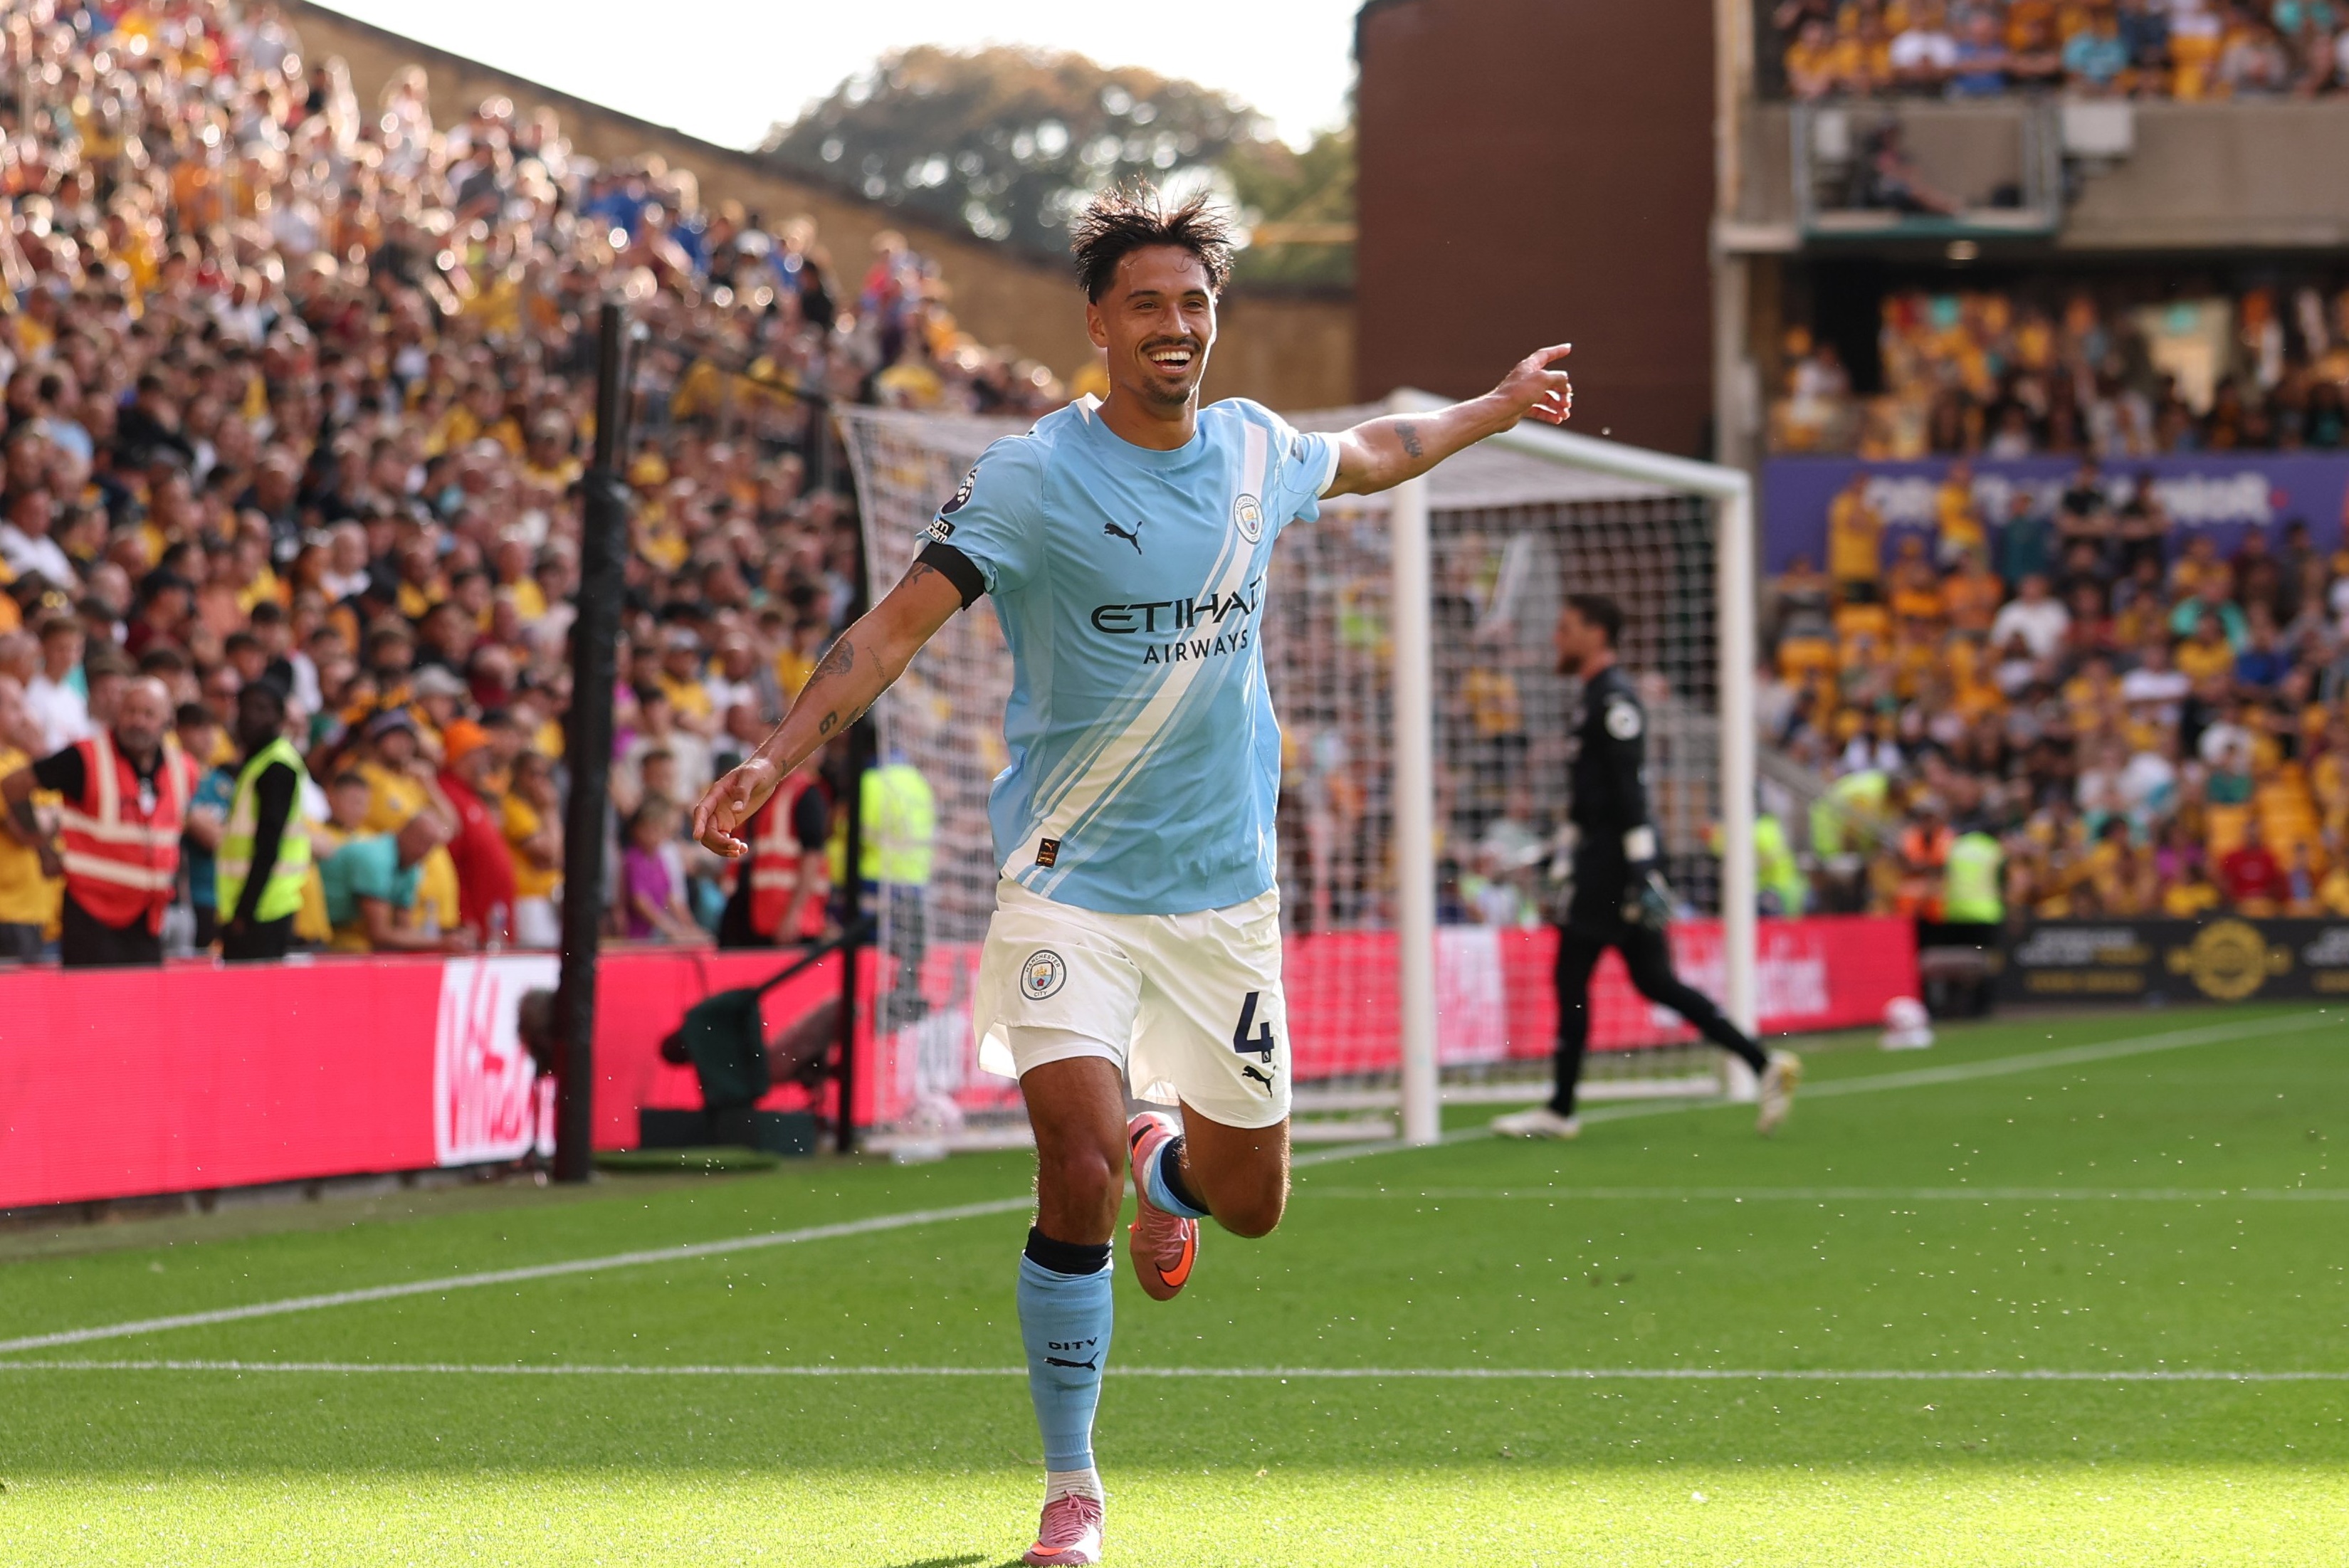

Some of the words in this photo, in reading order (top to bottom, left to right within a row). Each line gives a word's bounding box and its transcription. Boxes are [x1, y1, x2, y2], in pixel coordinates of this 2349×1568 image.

[1142, 629, 1249, 665] AIRWAYS
[1025, 953, 1061, 973] MANCHESTER
[1233, 991, 1275, 1063] 4
